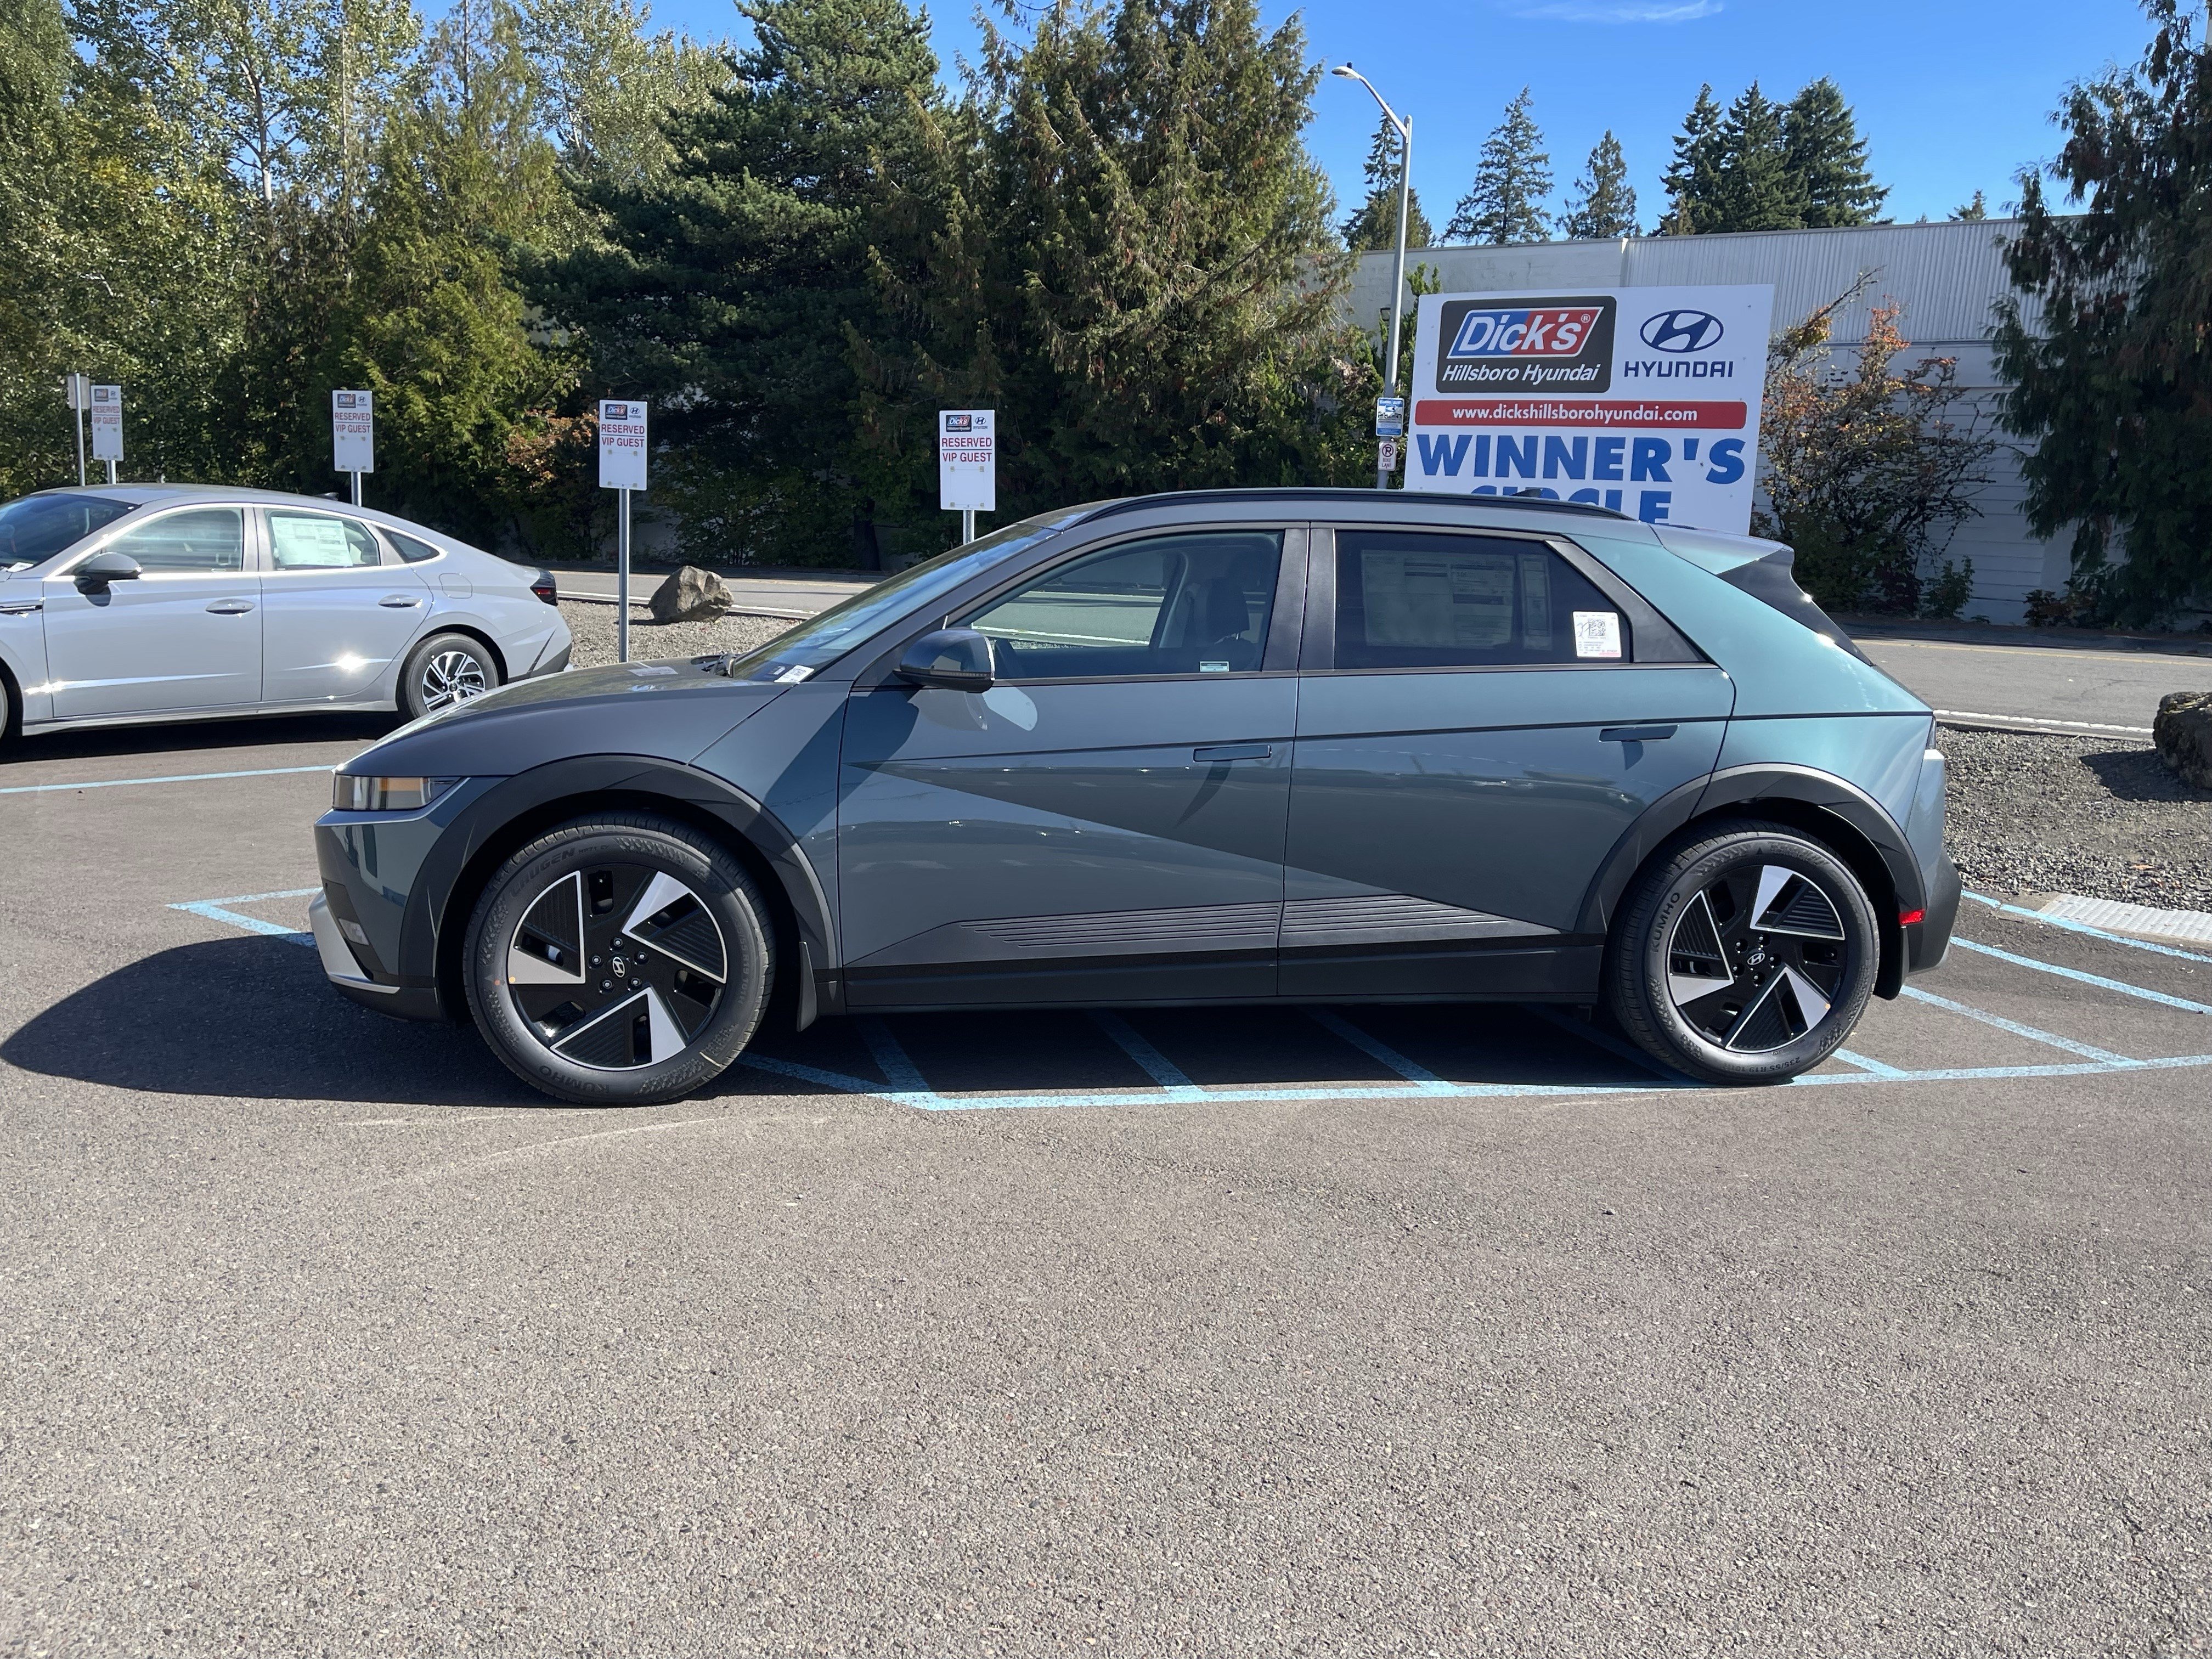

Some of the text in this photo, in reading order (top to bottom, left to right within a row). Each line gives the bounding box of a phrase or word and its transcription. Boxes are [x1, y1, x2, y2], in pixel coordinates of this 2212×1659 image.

[1458, 313, 1582, 351] Dick's
[1442, 363, 1601, 385] Hillsboro Hyundai
[1623, 360, 1734, 377] HYUNDAI
[335, 412, 371, 421] RESERVED
[1452, 403, 1698, 424] www.dickshillsborohyundai.com
[335, 424, 371, 433] VIP GUEST
[601, 424, 645, 435] RESERVED
[602, 437, 645, 448] VIP GUEST
[941, 437, 992, 448] RESERVED
[943, 452, 992, 462] VIP GUEST
[1416, 433, 1746, 484] WINNER'S
[1650, 892, 1680, 953] KUMHO
[1769, 1057, 1801, 1070] 235/55
[539, 1065, 610, 1094] KUMHO
